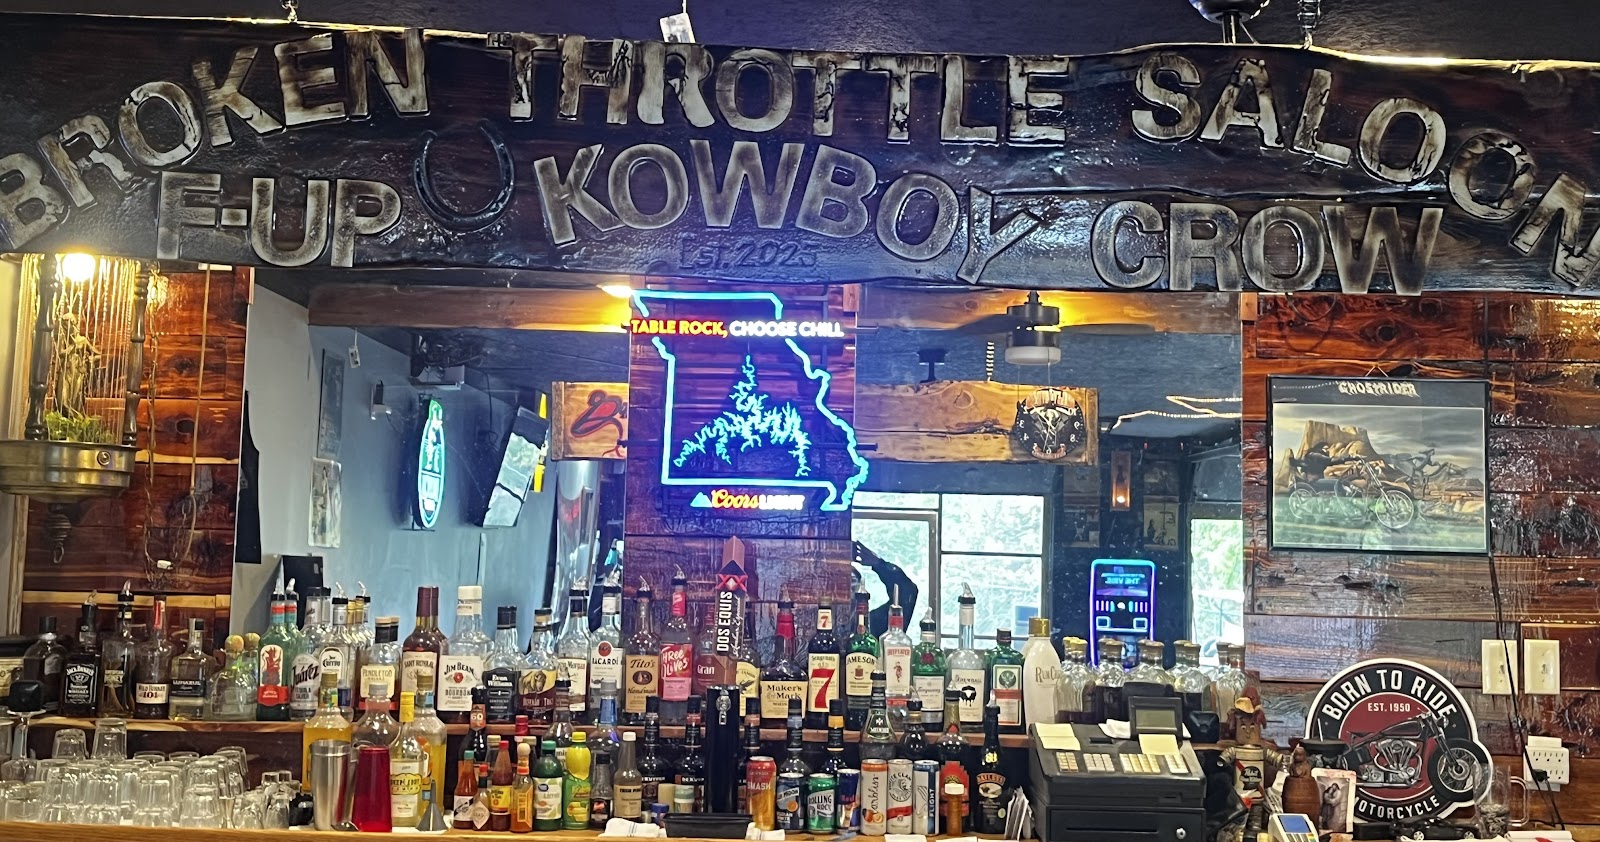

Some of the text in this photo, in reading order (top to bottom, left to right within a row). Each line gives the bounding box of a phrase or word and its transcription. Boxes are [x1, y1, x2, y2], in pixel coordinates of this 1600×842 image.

[0, 28, 1600, 288] BROKEN THROTTLE SALOON
[157, 139, 1444, 295] F-UP KOWBOY CROW
[736, 241, 818, 268] 2025
[631, 319, 845, 338] TABLE ROCK, CHOOSE CHILL
[711, 489, 805, 510] Coors LIGHT
[716, 591, 733, 652] DOS EQUIS
[820, 615, 829, 628] 7
[444, 661, 474, 675] JIM BEAM
[630, 659, 655, 669] Tito's
[767, 684, 802, 692] Maker's
[811, 668, 835, 708] 7
[1322, 669, 1457, 721] BORN TO RIDE
[471, 712, 483, 720] 60
[1367, 702, 1411, 712] EST. 1950
[747, 781, 771, 790] SMASH
